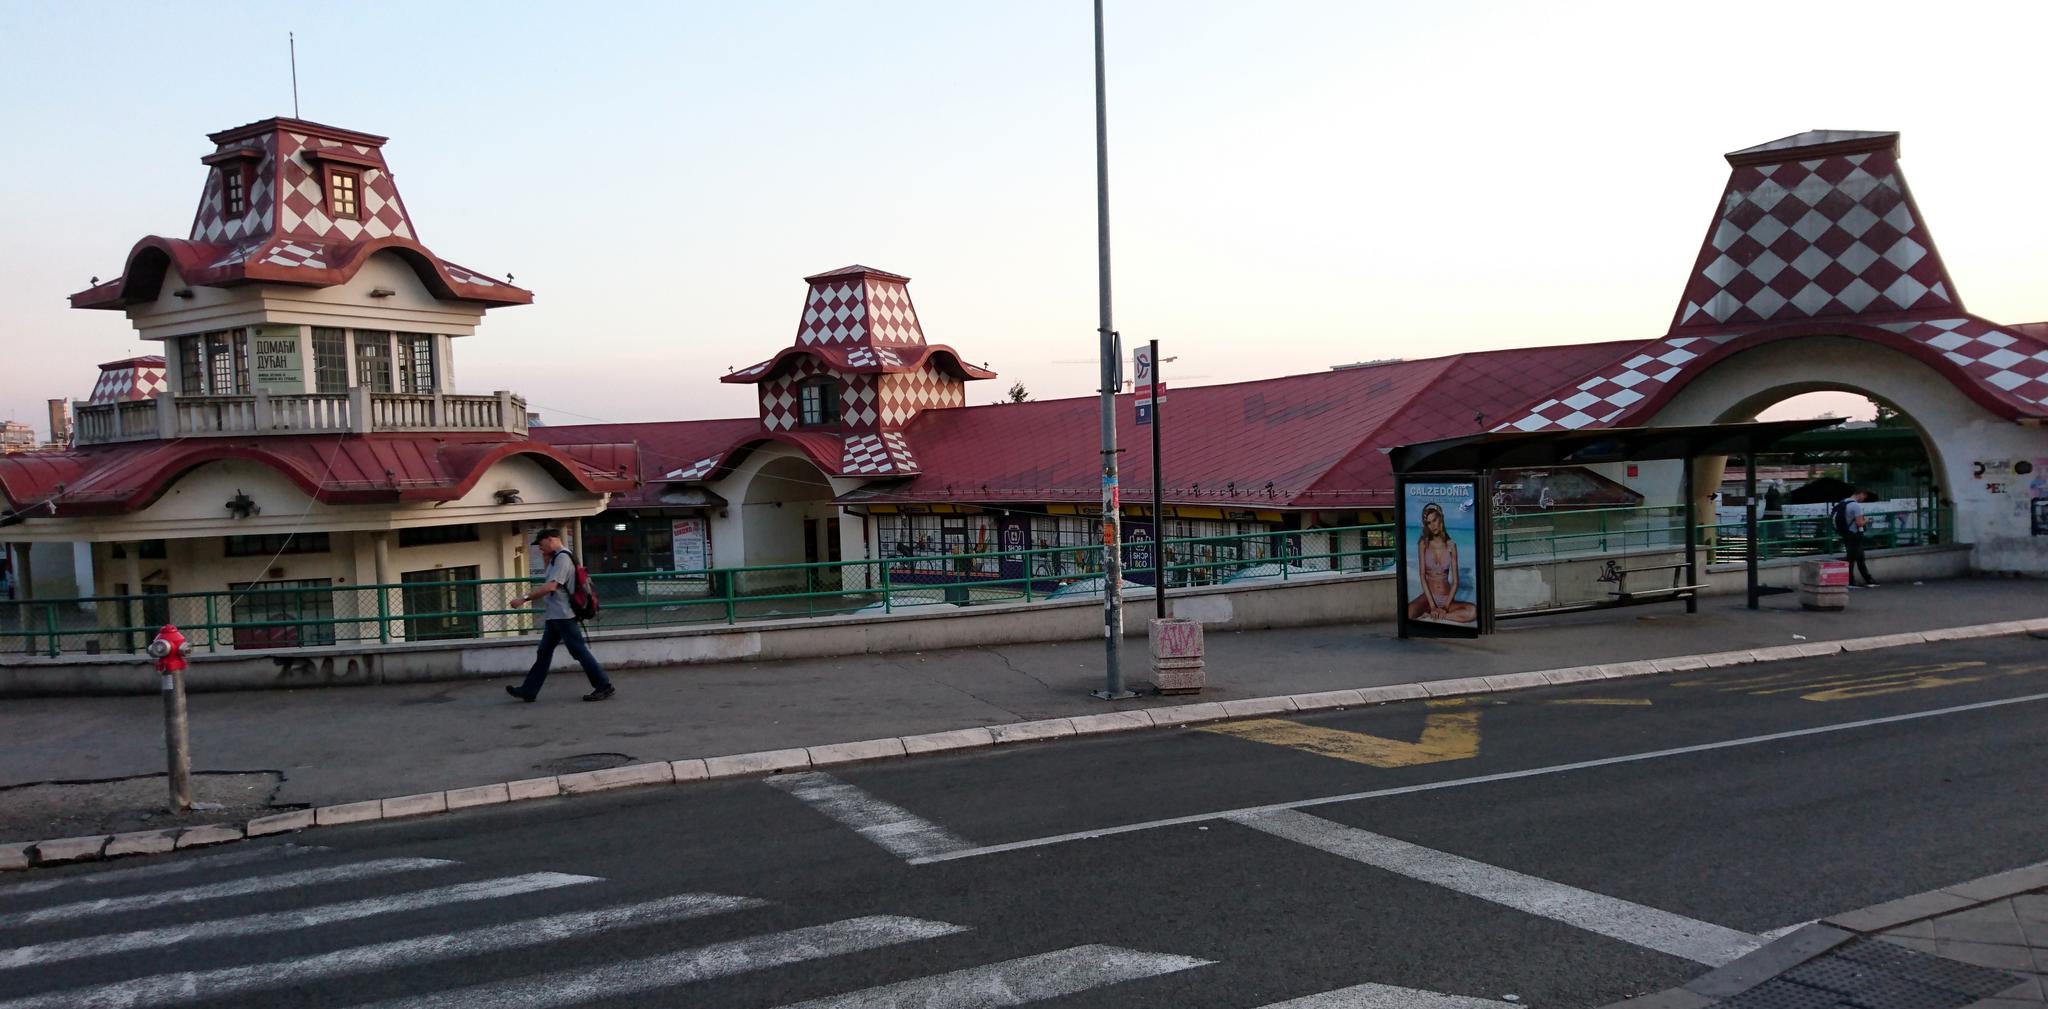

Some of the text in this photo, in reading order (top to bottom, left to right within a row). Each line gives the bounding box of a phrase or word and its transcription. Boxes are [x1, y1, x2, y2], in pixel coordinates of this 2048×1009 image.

[256, 340, 296, 354] ДОМАЋИ
[257, 355, 287, 369] ДУЋАН
[1410, 487, 1469, 496] CALZEDONIA
[1133, 552, 1149, 560] SHOP
